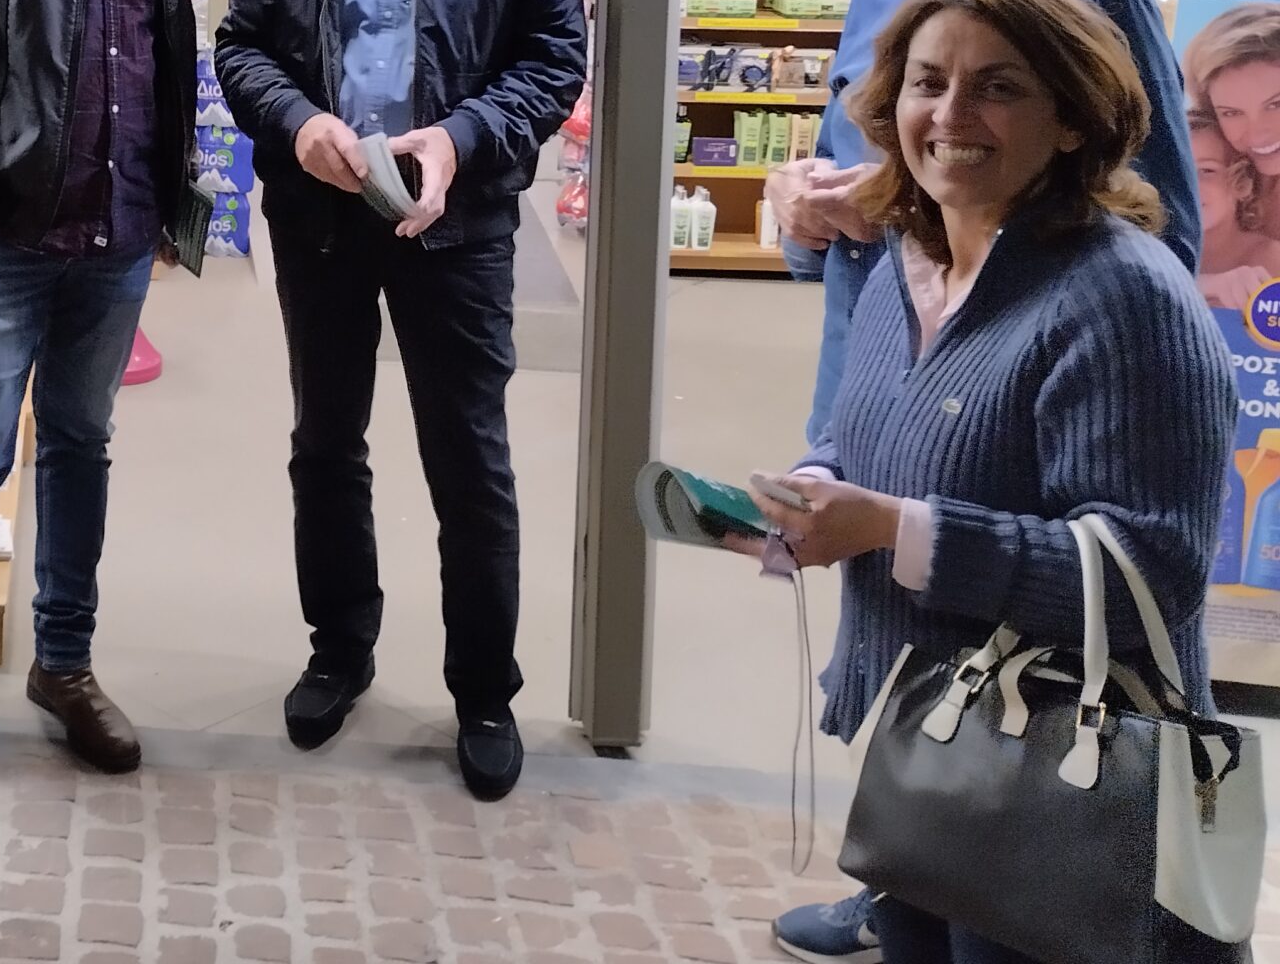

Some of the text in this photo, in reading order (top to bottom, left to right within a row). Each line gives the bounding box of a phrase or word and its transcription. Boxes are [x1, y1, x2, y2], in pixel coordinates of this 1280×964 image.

[208, 220, 232, 233] ios
[1258, 300, 1280, 313] NI
[1231, 354, 1280, 375] ΡΟΣ
[1239, 399, 1280, 419] ΟΝ
